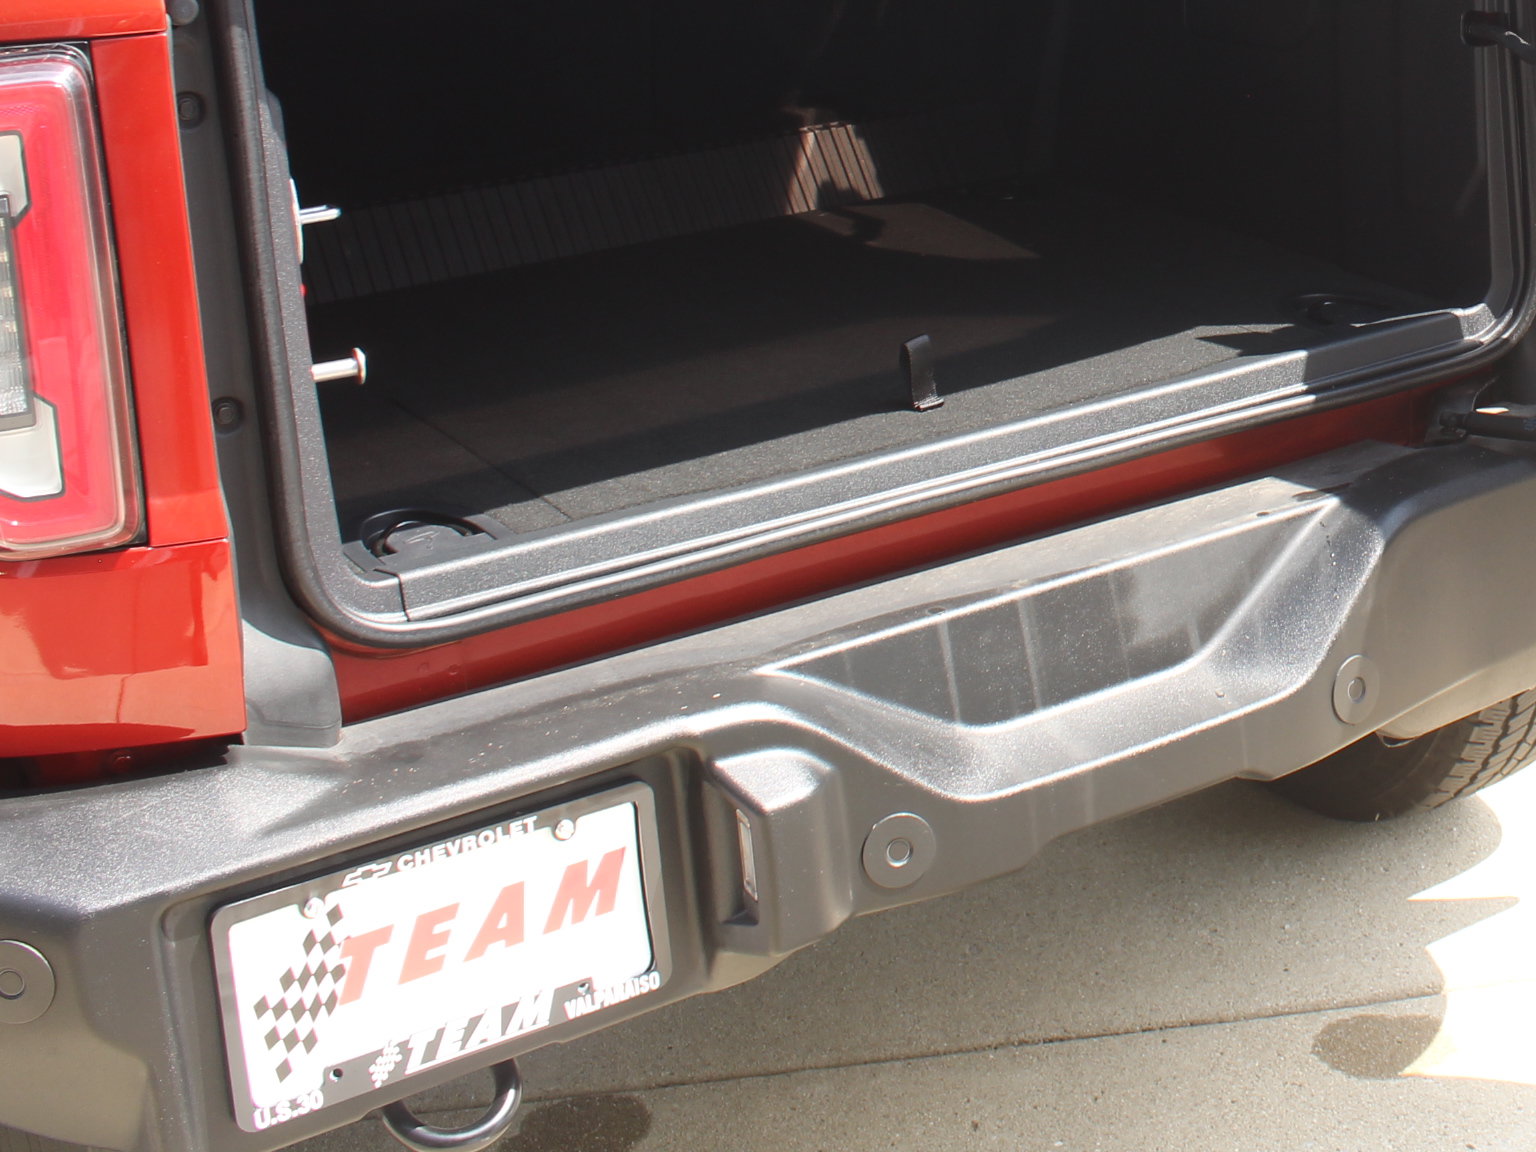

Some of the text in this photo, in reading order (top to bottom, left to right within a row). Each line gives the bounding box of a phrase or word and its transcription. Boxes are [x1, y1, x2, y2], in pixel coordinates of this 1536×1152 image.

[396, 815, 538, 872] CHEVROLET
[338, 846, 627, 1007] TEAM
[404, 988, 556, 1075] TEAM
[563, 970, 661, 1020] VALPARAISO
